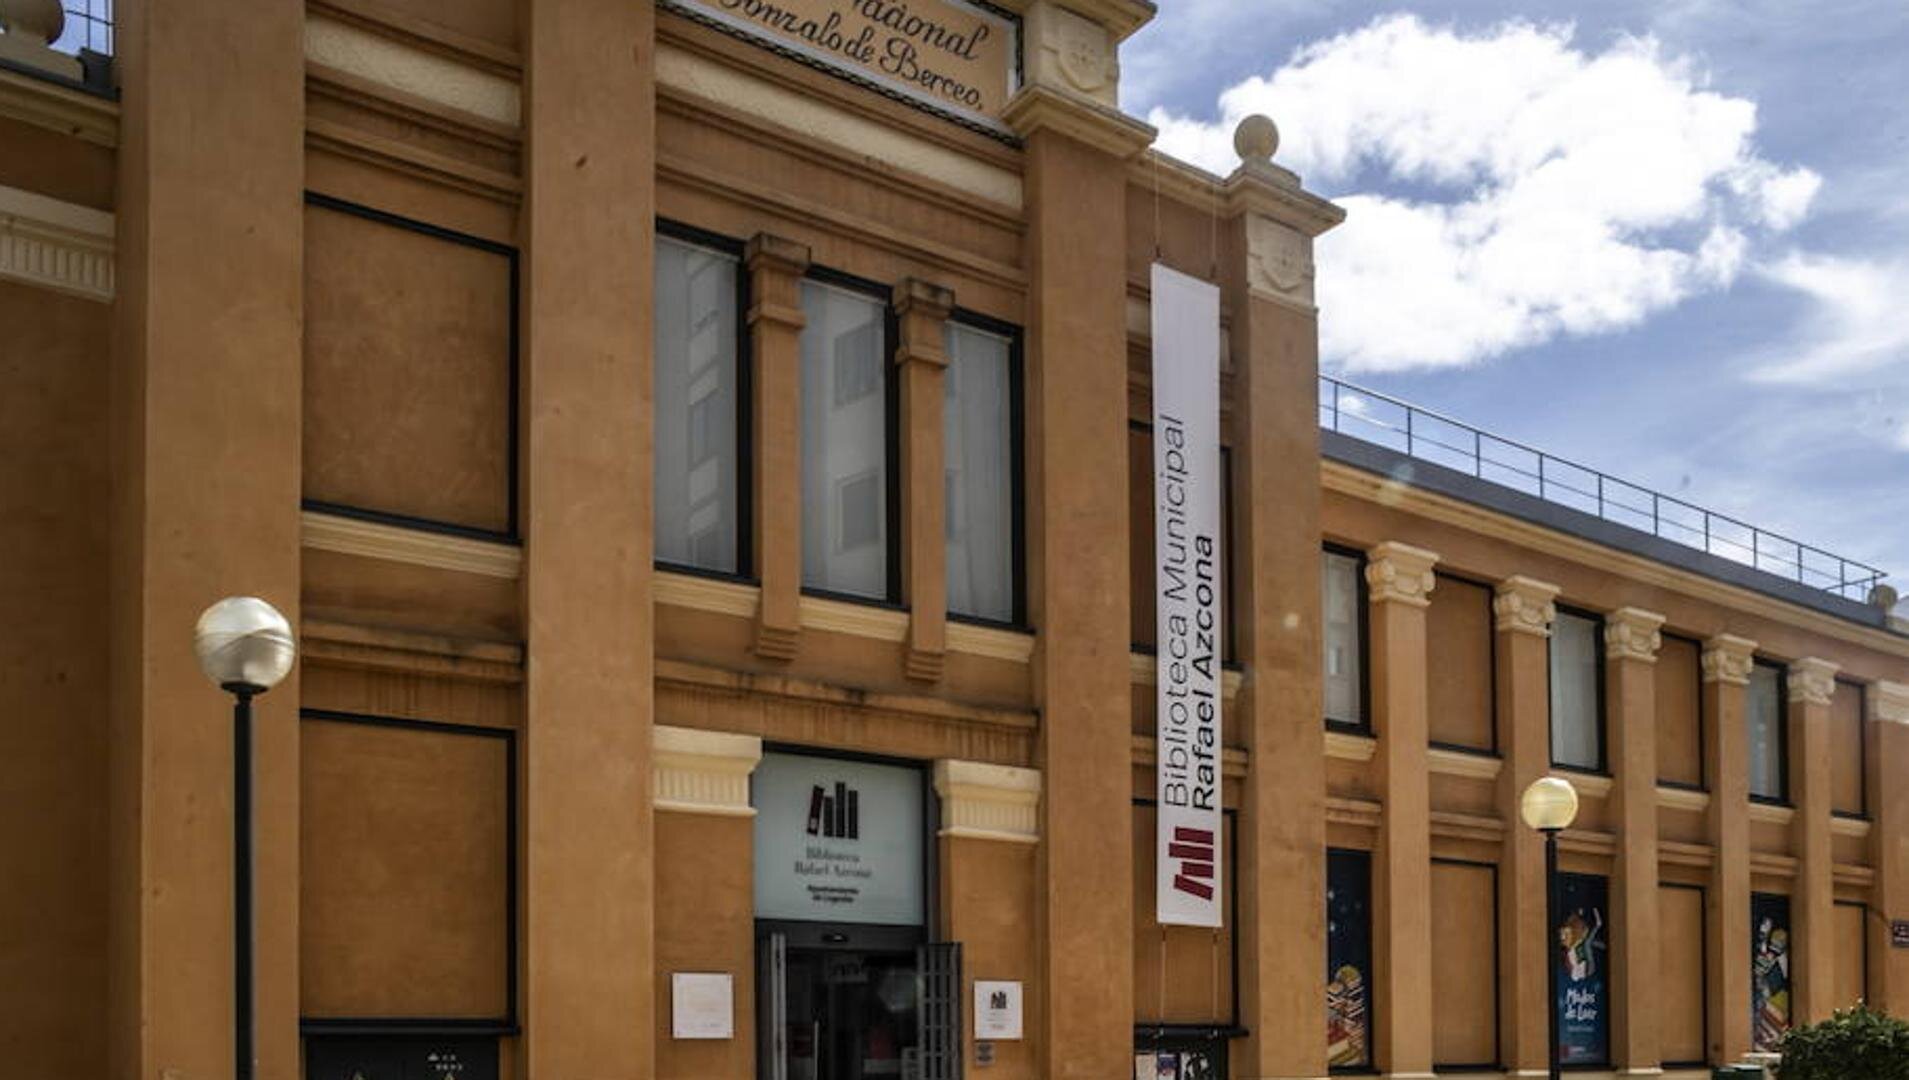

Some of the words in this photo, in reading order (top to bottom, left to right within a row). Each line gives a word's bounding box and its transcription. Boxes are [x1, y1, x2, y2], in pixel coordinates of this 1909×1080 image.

[844, 26, 875, 62] de
[852, 0, 989, 60] acional
[1159, 414, 1188, 601] Municipal
[1192, 535, 1214, 680] Azcona
[1164, 615, 1189, 807] Biblioteca
[1192, 689, 1214, 811] Rafael
